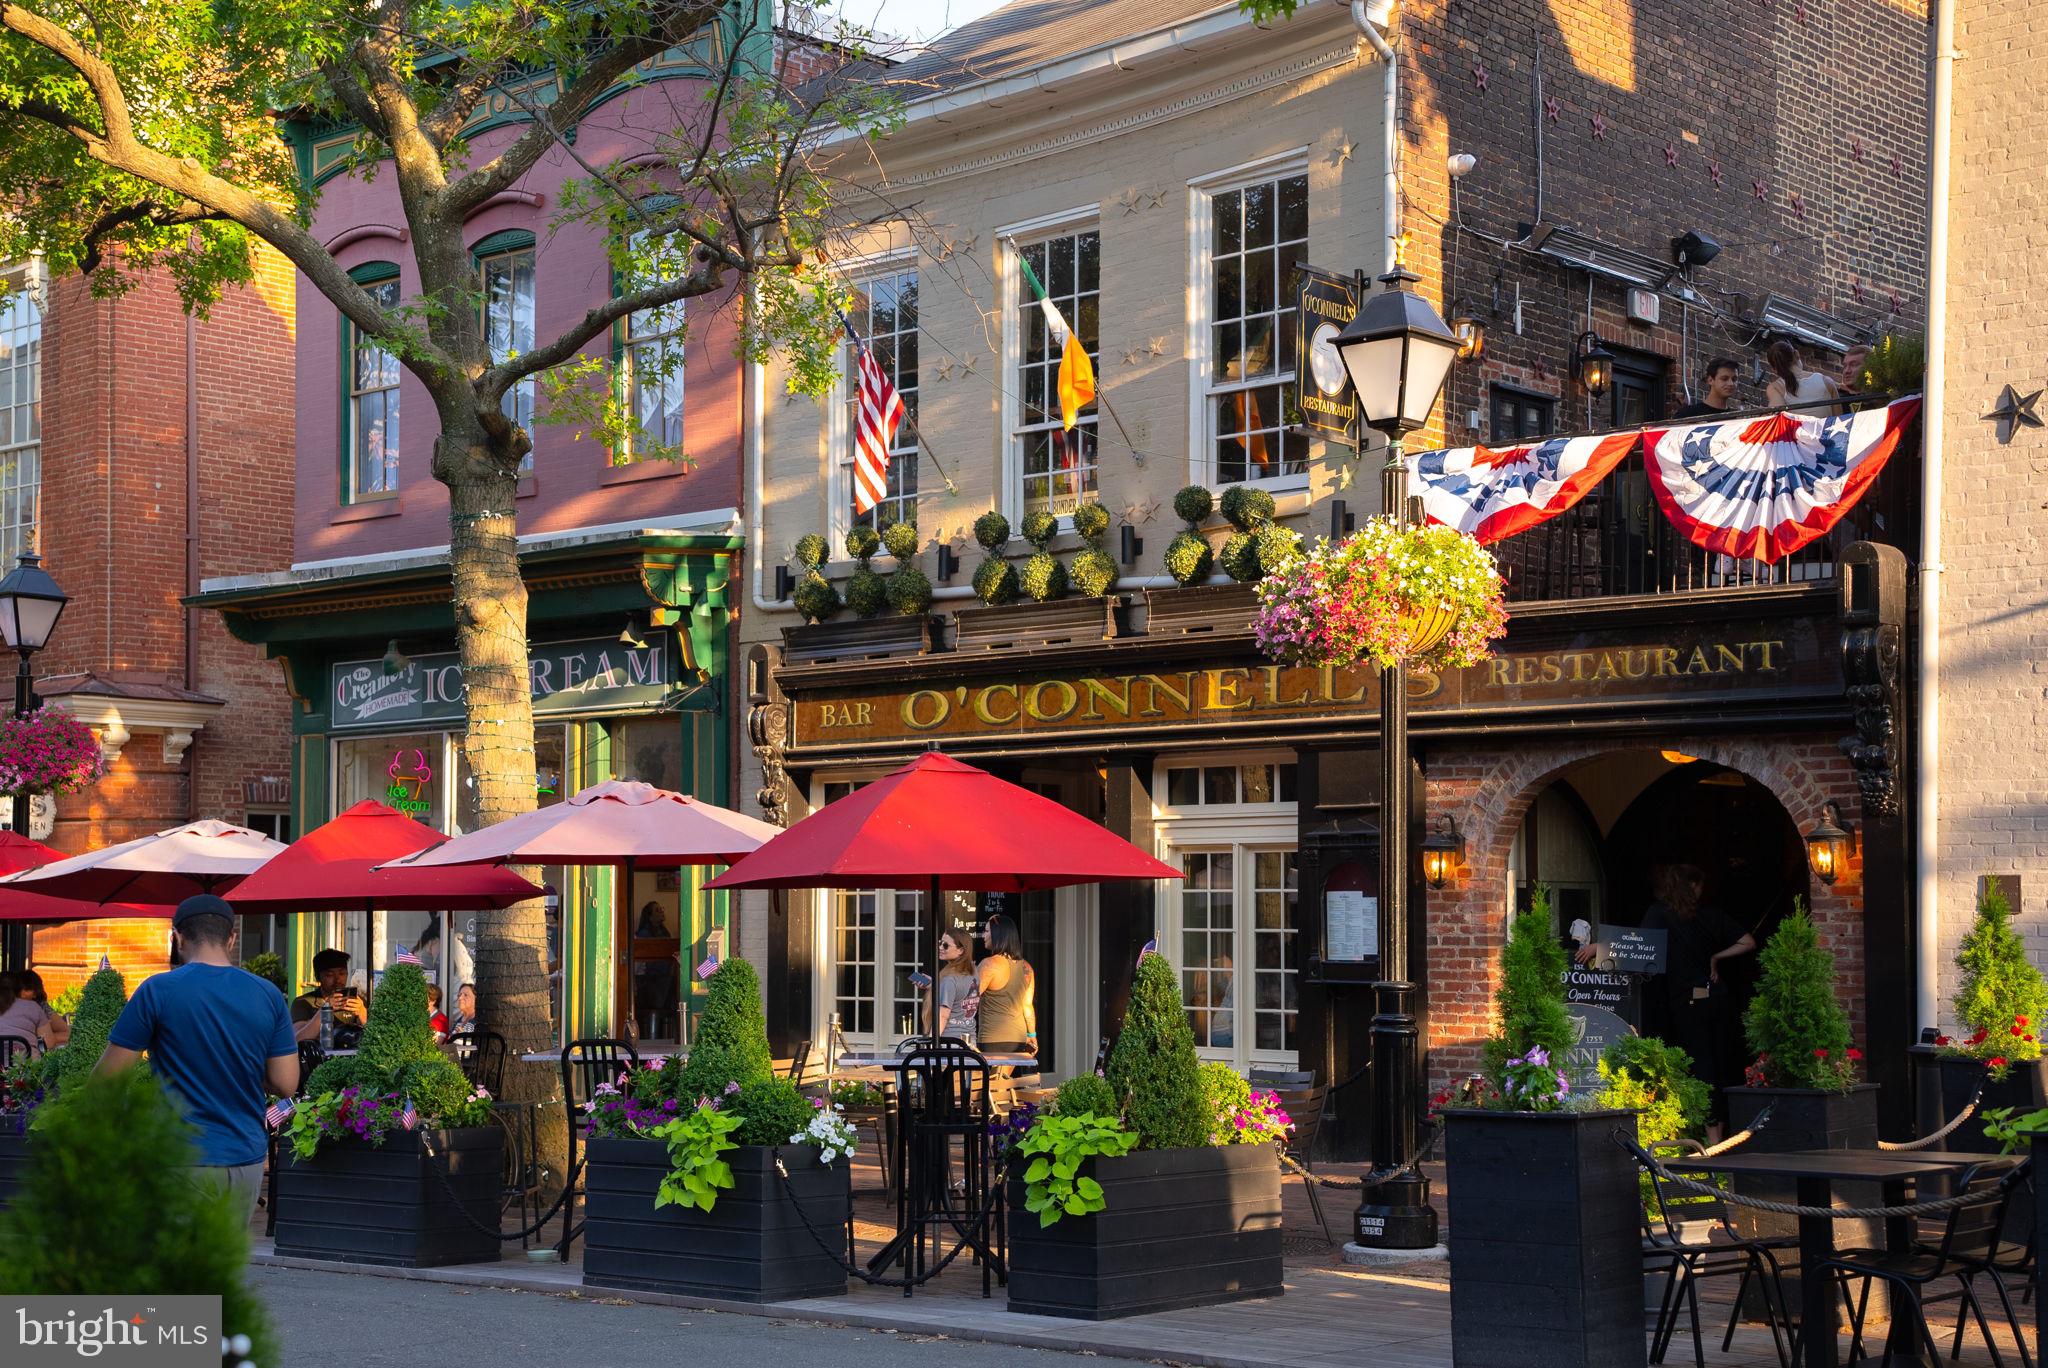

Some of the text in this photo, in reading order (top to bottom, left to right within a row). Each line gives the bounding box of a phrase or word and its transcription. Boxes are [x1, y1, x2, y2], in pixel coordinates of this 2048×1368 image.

[1304, 294, 1355, 322] O'CONNELL'S
[1303, 395, 1352, 418] RESTAURANT
[355, 668, 370, 679] The
[422, 647, 662, 703] IC REAM
[820, 702, 872, 727] BAR
[1486, 640, 1784, 687] RESTAURANT
[365, 693, 408, 715] HOMEMADE
[387, 784, 408, 798] Ice
[1610, 942, 1656, 952] Please Wait
[1560, 971, 1629, 986] O'CONNELL'S
[1568, 988, 1621, 1003] Open Hours
